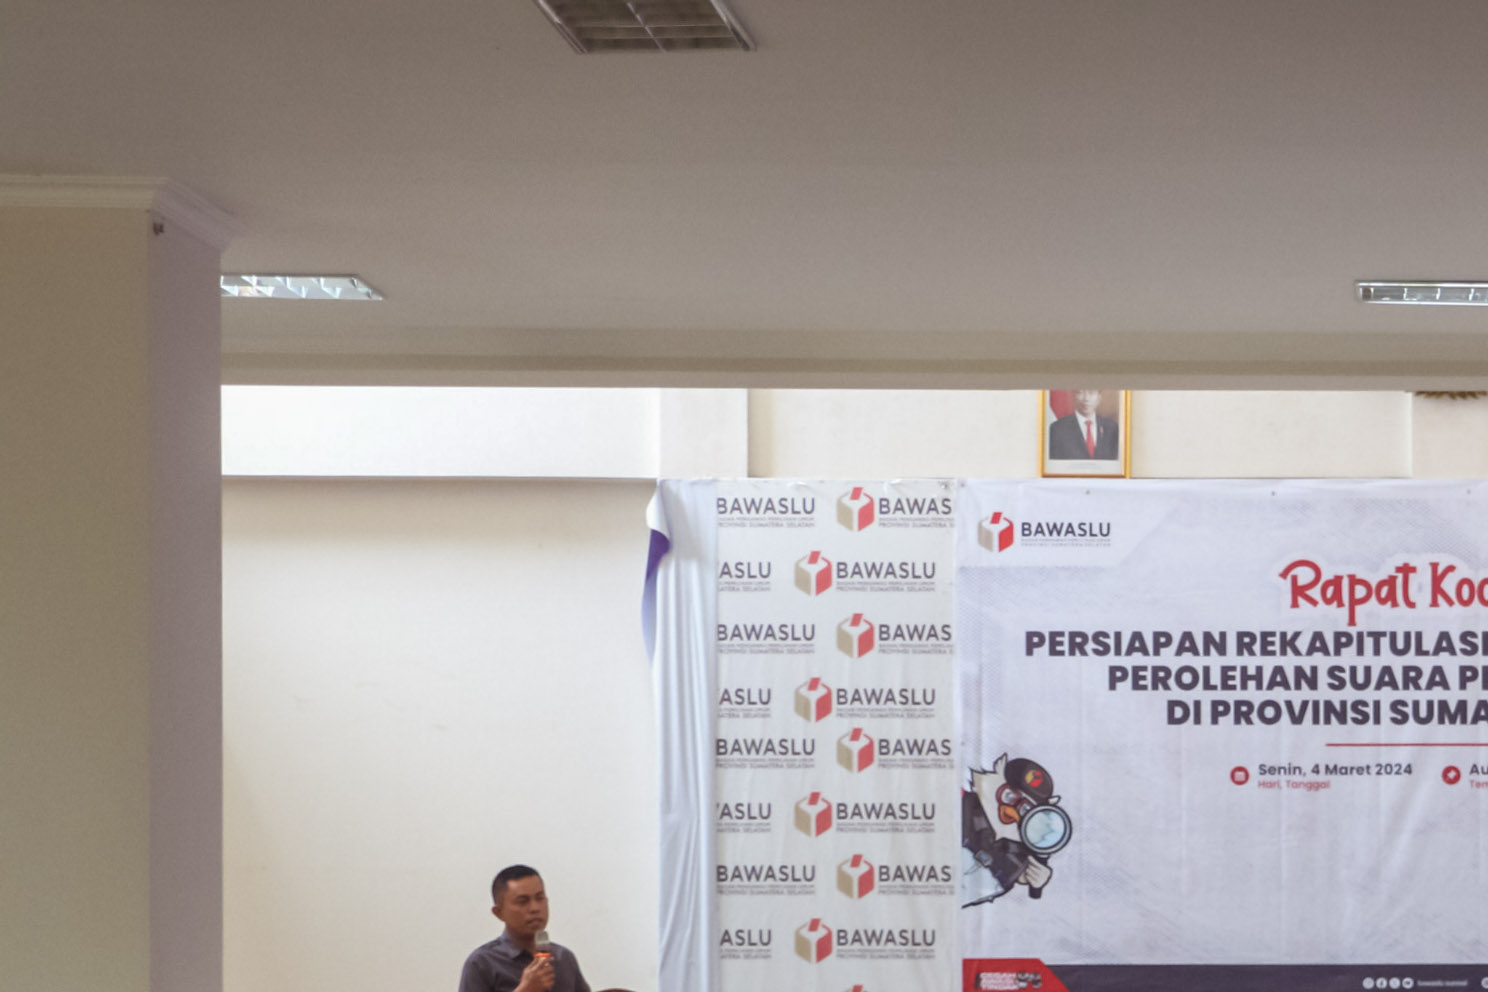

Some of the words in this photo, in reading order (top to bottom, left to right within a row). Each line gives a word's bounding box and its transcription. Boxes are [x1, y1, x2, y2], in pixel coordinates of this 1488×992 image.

[717, 497, 815, 515] BAWASLU
[1021, 521, 1111, 537] BAWASLU
[836, 561, 936, 579] BAWASLU
[1279, 559, 1416, 627] Rapat
[717, 624, 815, 641] BAWASLU
[1025, 631, 1227, 656] PERSIAPAN
[1108, 665, 1318, 691] PEROLEHAN
[1326, 665, 1450, 691] SUARA
[836, 688, 936, 706] BAWASLU
[1167, 700, 1201, 725] DI
[1210, 700, 1381, 725] PROVINSI
[716, 738, 815, 756] BAWASLU
[1258, 763, 1306, 777] Senin,
[1311, 764, 1320, 775] 4
[1325, 764, 1370, 775] Maret
[1375, 764, 1412, 775] 2024
[1286, 780, 1330, 791] Tanggal
[717, 802, 771, 820] ASLU
[836, 802, 936, 820] BAWASLU
[716, 865, 815, 883] BAWASLU
[836, 929, 936, 947] BAWASLU
